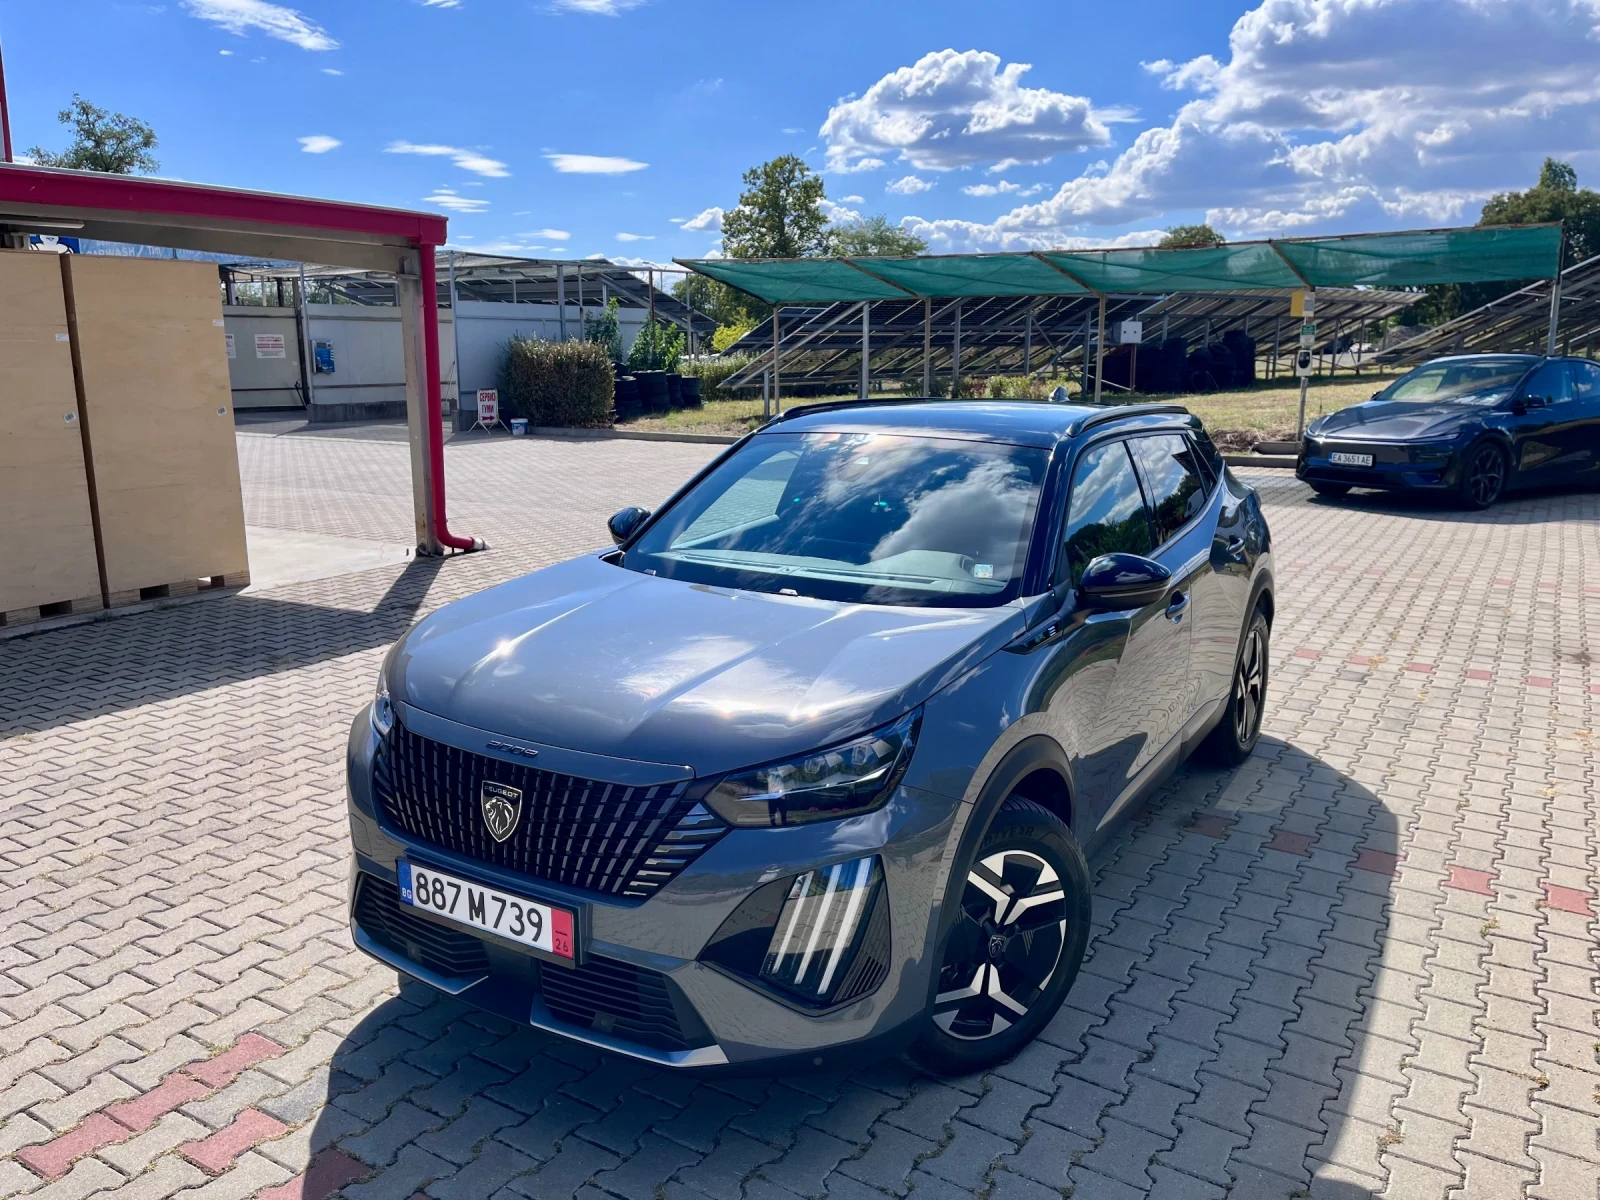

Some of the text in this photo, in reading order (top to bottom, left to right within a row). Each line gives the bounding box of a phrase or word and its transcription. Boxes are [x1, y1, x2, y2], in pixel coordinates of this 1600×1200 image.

[86, 247, 135, 257] RWASH
[484, 785, 519, 799] PEUGEOT
[401, 887, 412, 900] BG
[415, 872, 543, 943] 887 M 739
[555, 937, 569, 952] 26
